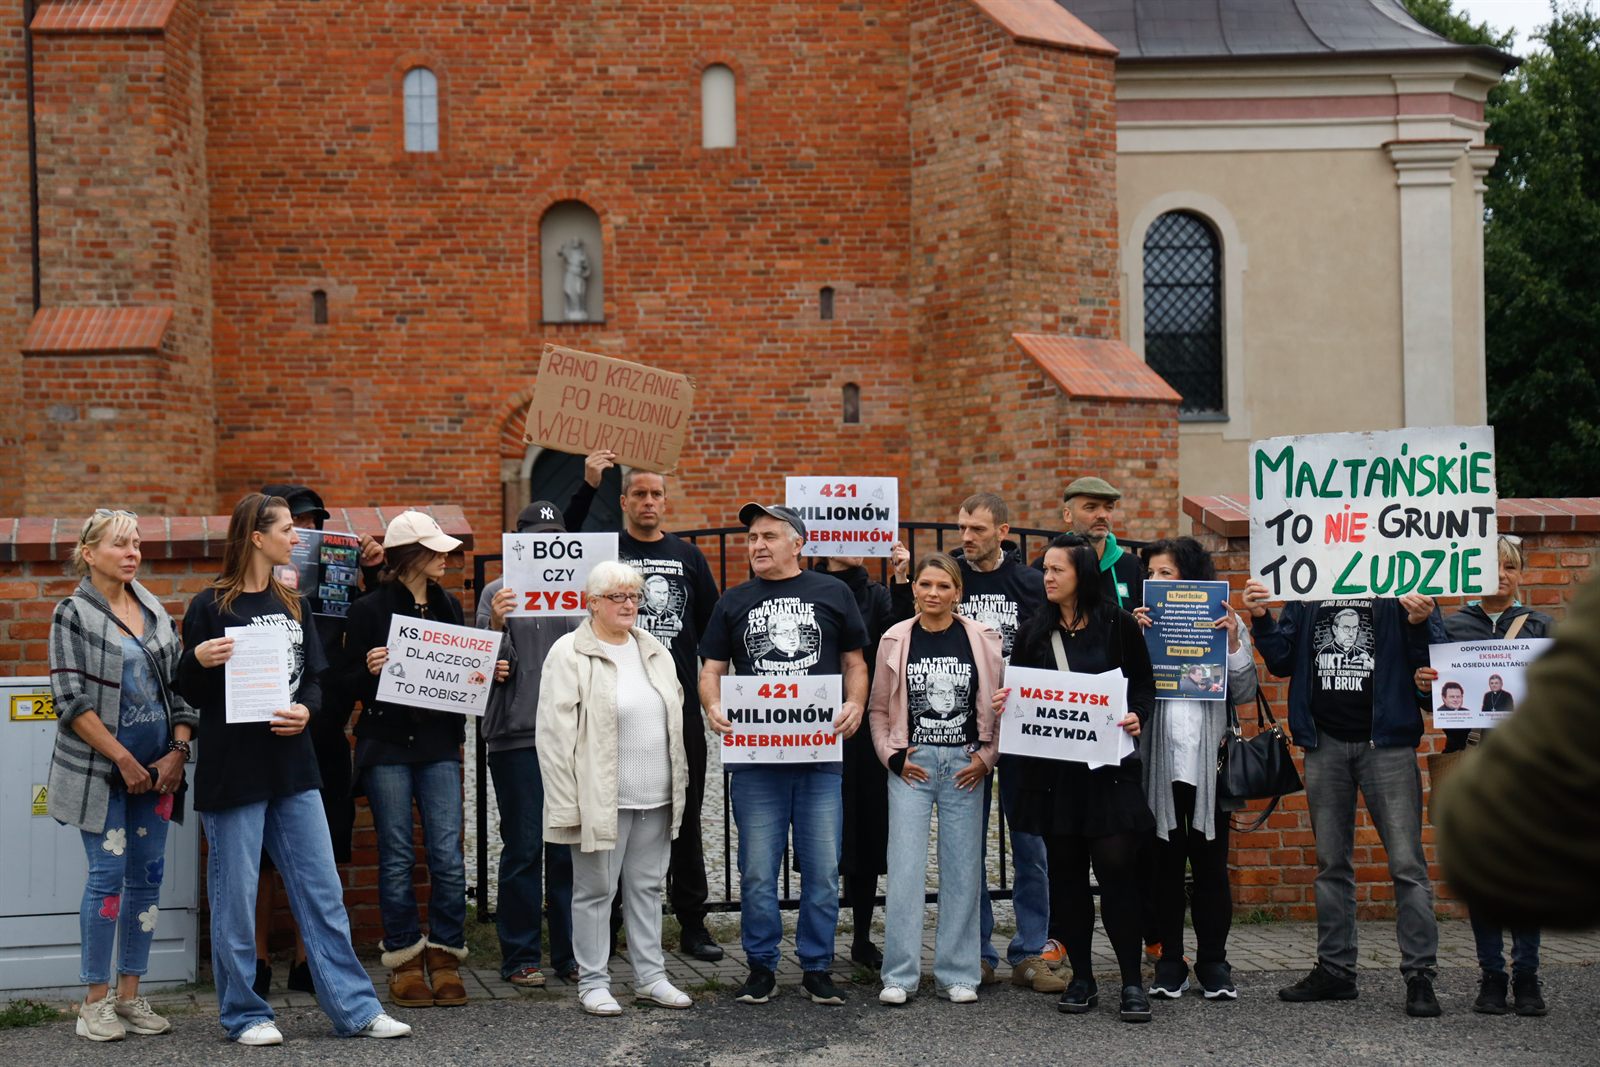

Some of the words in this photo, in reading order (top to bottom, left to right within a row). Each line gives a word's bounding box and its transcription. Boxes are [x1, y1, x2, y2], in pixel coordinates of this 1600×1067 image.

[547, 352, 598, 382] RANO
[604, 364, 683, 400] KAZANIE
[561, 385, 591, 411] PO
[597, 392, 683, 430] POŁUDNIU
[538, 410, 674, 466] WYBURZANIE
[820, 483, 857, 497] 421
[1265, 509, 1313, 546] TO
[1378, 503, 1494, 539] GRUNT
[533, 536, 583, 560] BÓG
[543, 569, 575, 582] CZY
[1260, 555, 1317, 595] TO
[763, 599, 773, 607] NA
[774, 597, 800, 605] PEWNO
[406, 647, 481, 669] DLACZEGO
[932, 656, 958, 664] PEWNO
[1319, 653, 1345, 669] NIKT
[425, 669, 460, 683] NAM
[1334, 676, 1363, 691] BRUK
[395, 681, 415, 694] TO
[757, 683, 798, 698] 421
[1020, 687, 1064, 702] WASZ
[1068, 691, 1110, 706] ZYSK
[727, 704, 834, 723] MILIONÓW
[1036, 706, 1090, 722] NASZA
[1021, 723, 1097, 742] KRZYWDA
